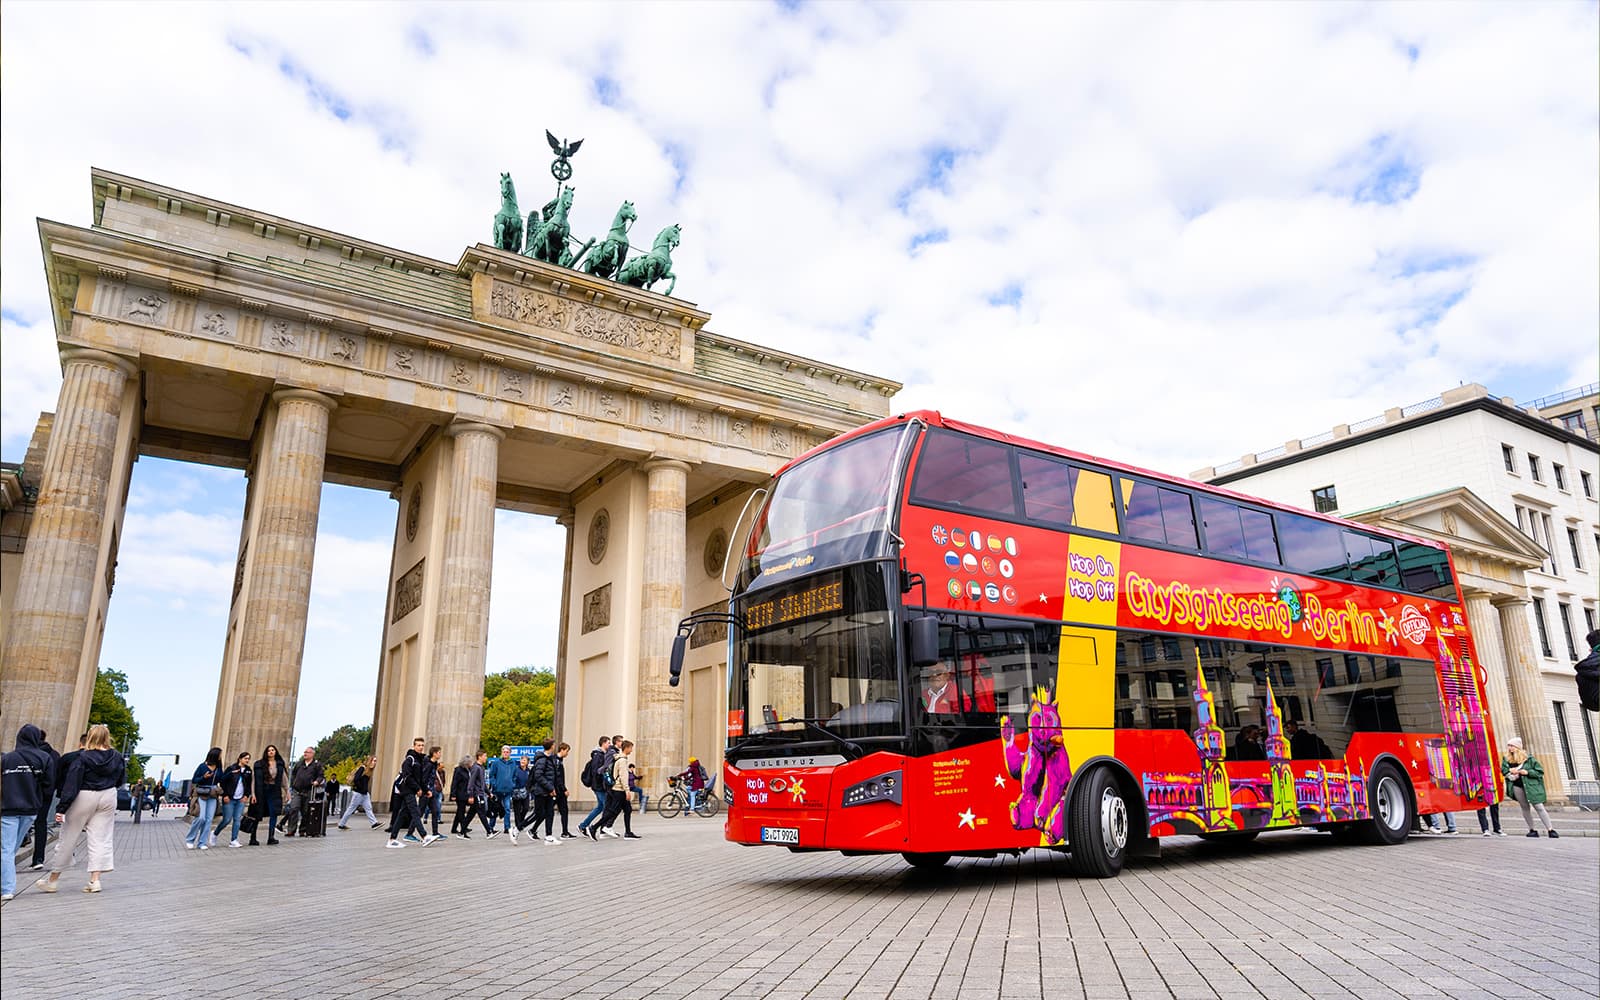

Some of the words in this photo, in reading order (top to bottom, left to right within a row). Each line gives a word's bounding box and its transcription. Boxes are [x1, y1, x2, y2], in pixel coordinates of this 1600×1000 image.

[1069, 553, 1095, 577] Hop
[1096, 555, 1114, 576] On
[1069, 577, 1095, 602] Hop
[1096, 579, 1115, 601] Off
[1126, 571, 1293, 638] CitySightseeing
[1305, 593, 1379, 645] Berlin
[1403, 618, 1428, 633] OFFICIAL
[746, 778, 757, 789] Hop
[757, 777, 765, 789] On
[748, 793, 759, 804] Hop
[759, 792, 768, 803] Off
[782, 830, 798, 841] 9924
